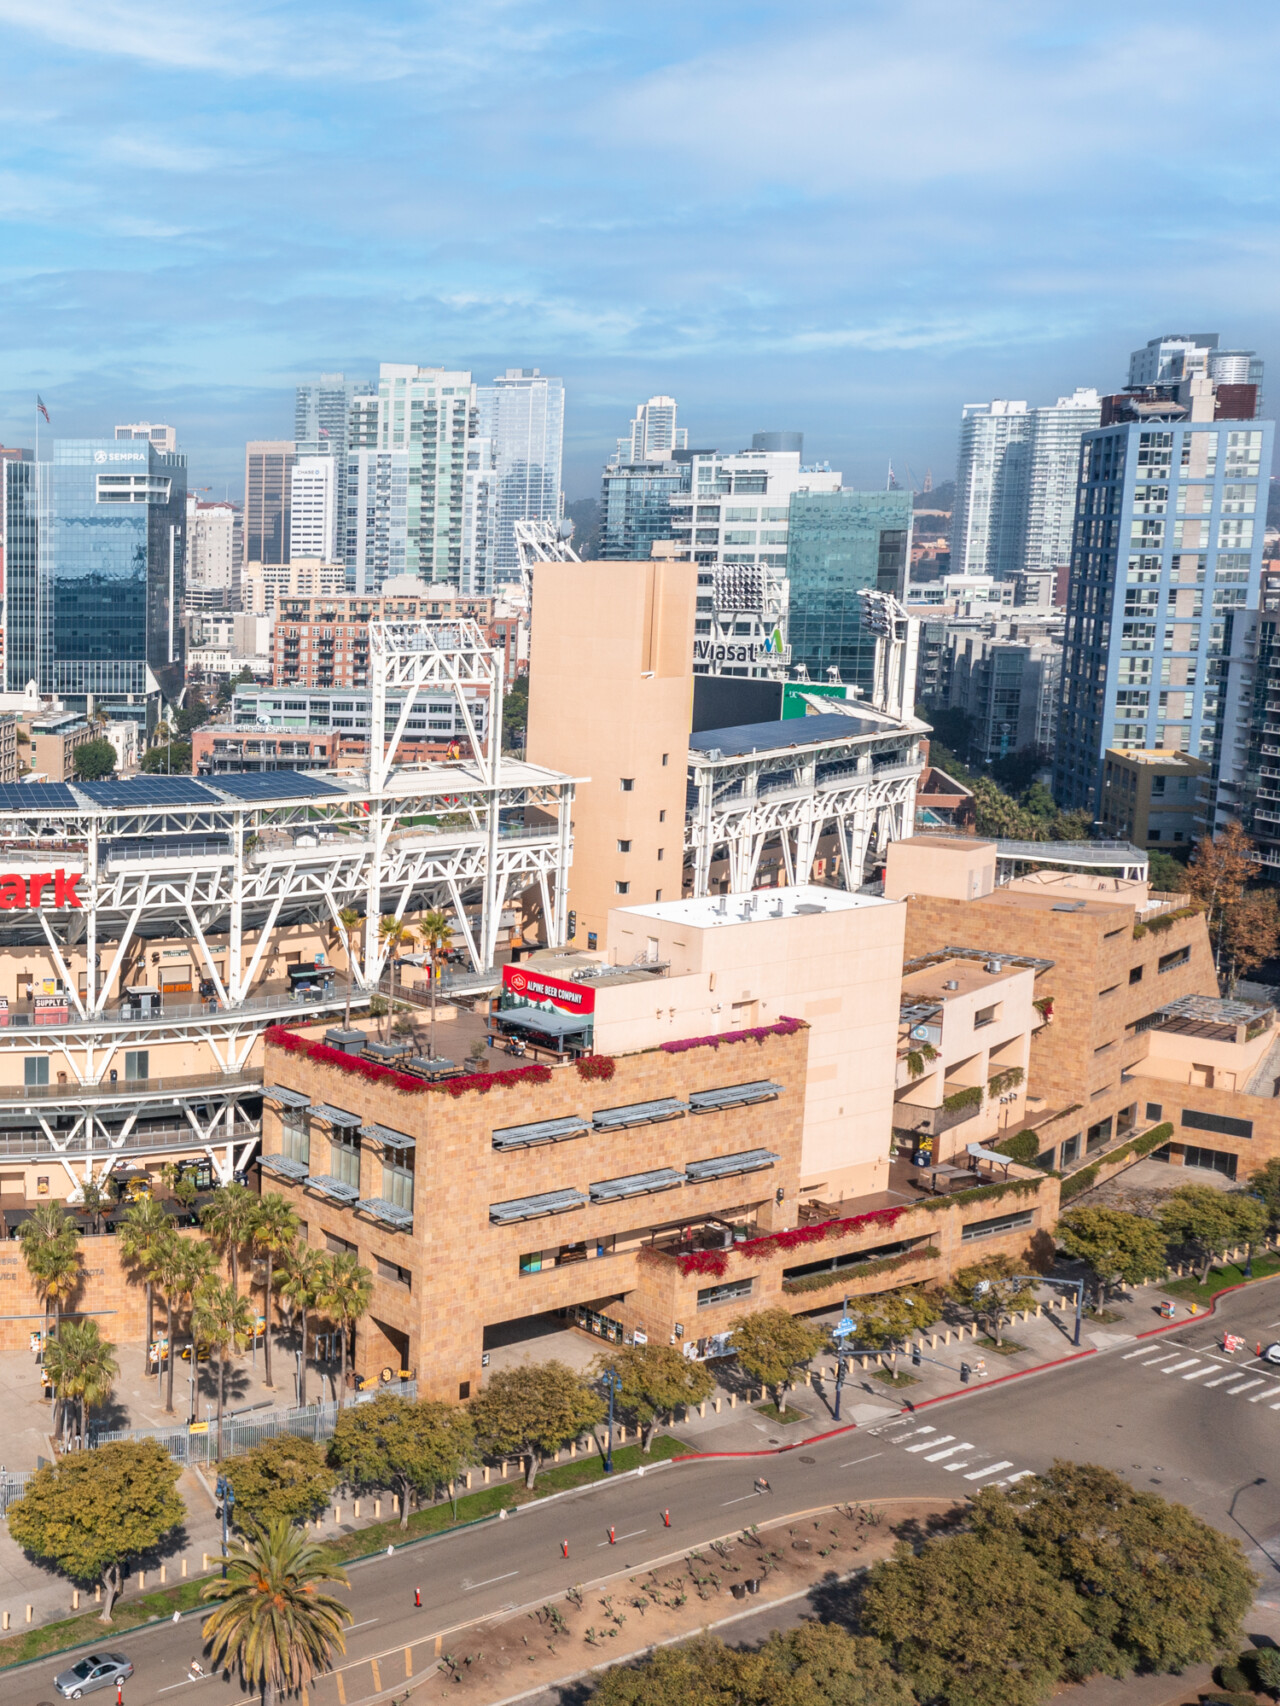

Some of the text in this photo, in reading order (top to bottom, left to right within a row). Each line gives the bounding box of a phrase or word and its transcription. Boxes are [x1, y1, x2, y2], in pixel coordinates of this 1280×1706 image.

[698, 640, 756, 662] Viasat
[527, 981, 582, 1004] ALPINE BEER COMPANY
